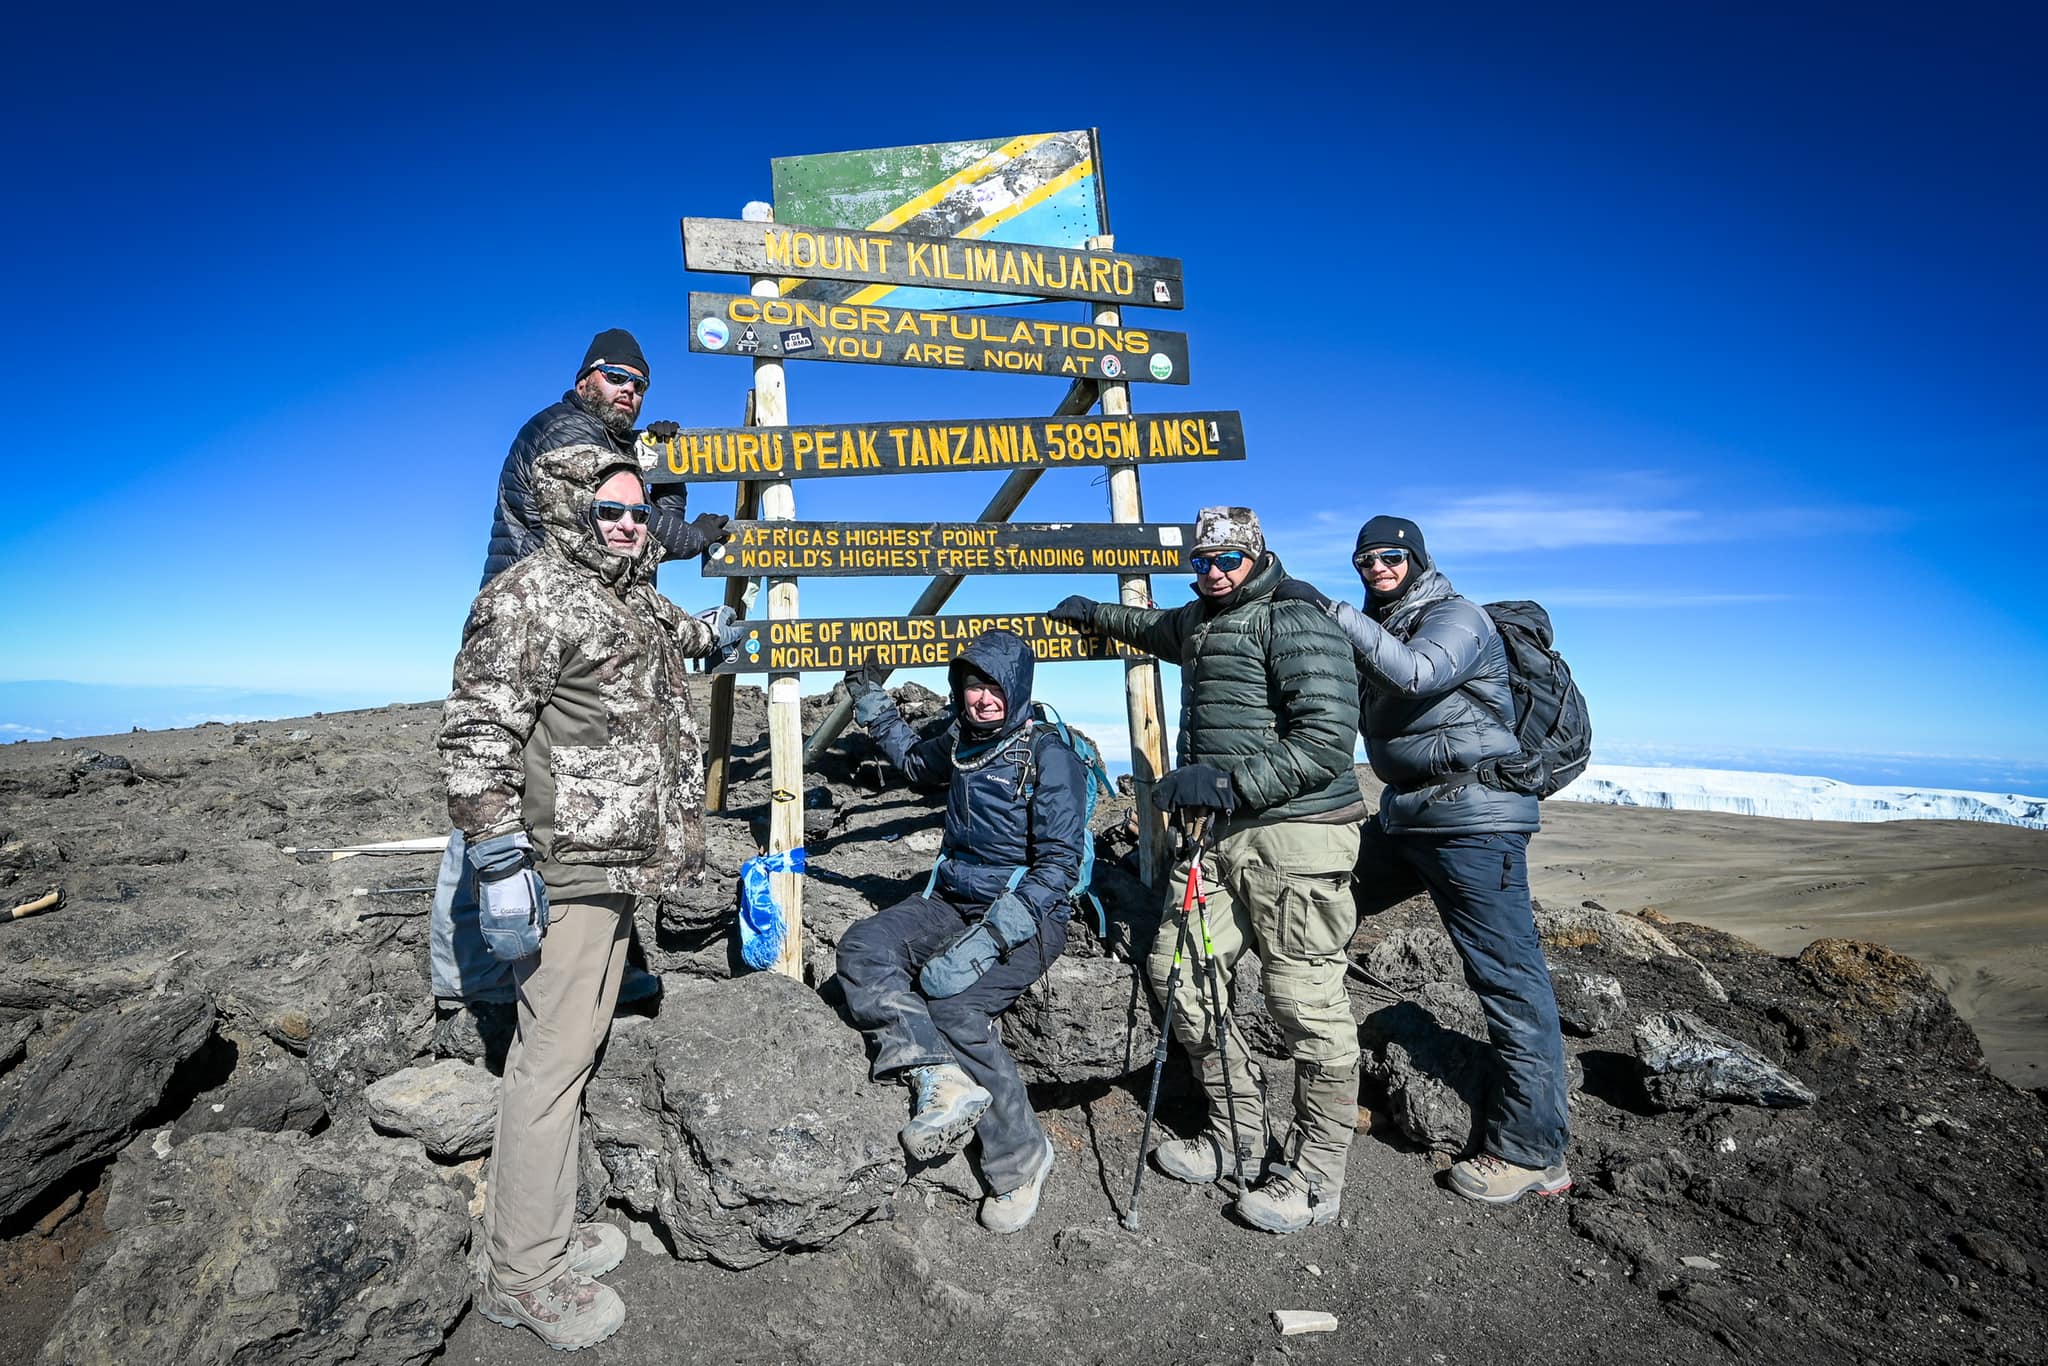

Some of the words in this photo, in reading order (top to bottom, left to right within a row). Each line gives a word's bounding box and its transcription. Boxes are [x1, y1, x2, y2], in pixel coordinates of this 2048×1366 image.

[765, 230, 893, 273] MOUNT
[907, 242, 1134, 295] KILIMANJARO
[728, 298, 1150, 354] CONGRATULATIONS
[821, 336, 883, 359] YOU
[904, 343, 965, 365] ARE
[984, 350, 1043, 372] NOW
[1062, 355, 1094, 375] AT
[666, 433, 784, 475] UHURU
[792, 430, 881, 470] PEAK
[1045, 421, 1140, 460] 5895M
[1149, 419, 1219, 457] AMSL
[846, 530, 933, 546] HIGHEST
[942, 530, 998, 546] POINT
[741, 549, 833, 567] WORLD'S
[839, 549, 931, 568] HIGHEST
[937, 549, 989, 567] FREE
[993, 549, 1085, 567] STANDING
[1092, 548, 1179, 567] MOUNTAIN
[770, 623, 814, 644] ONE
[819, 622, 844, 643] OF
[850, 620, 935, 642] WORLD'S
[770, 647, 843, 668] WORLD
[1077, 636, 1099, 656] OF
